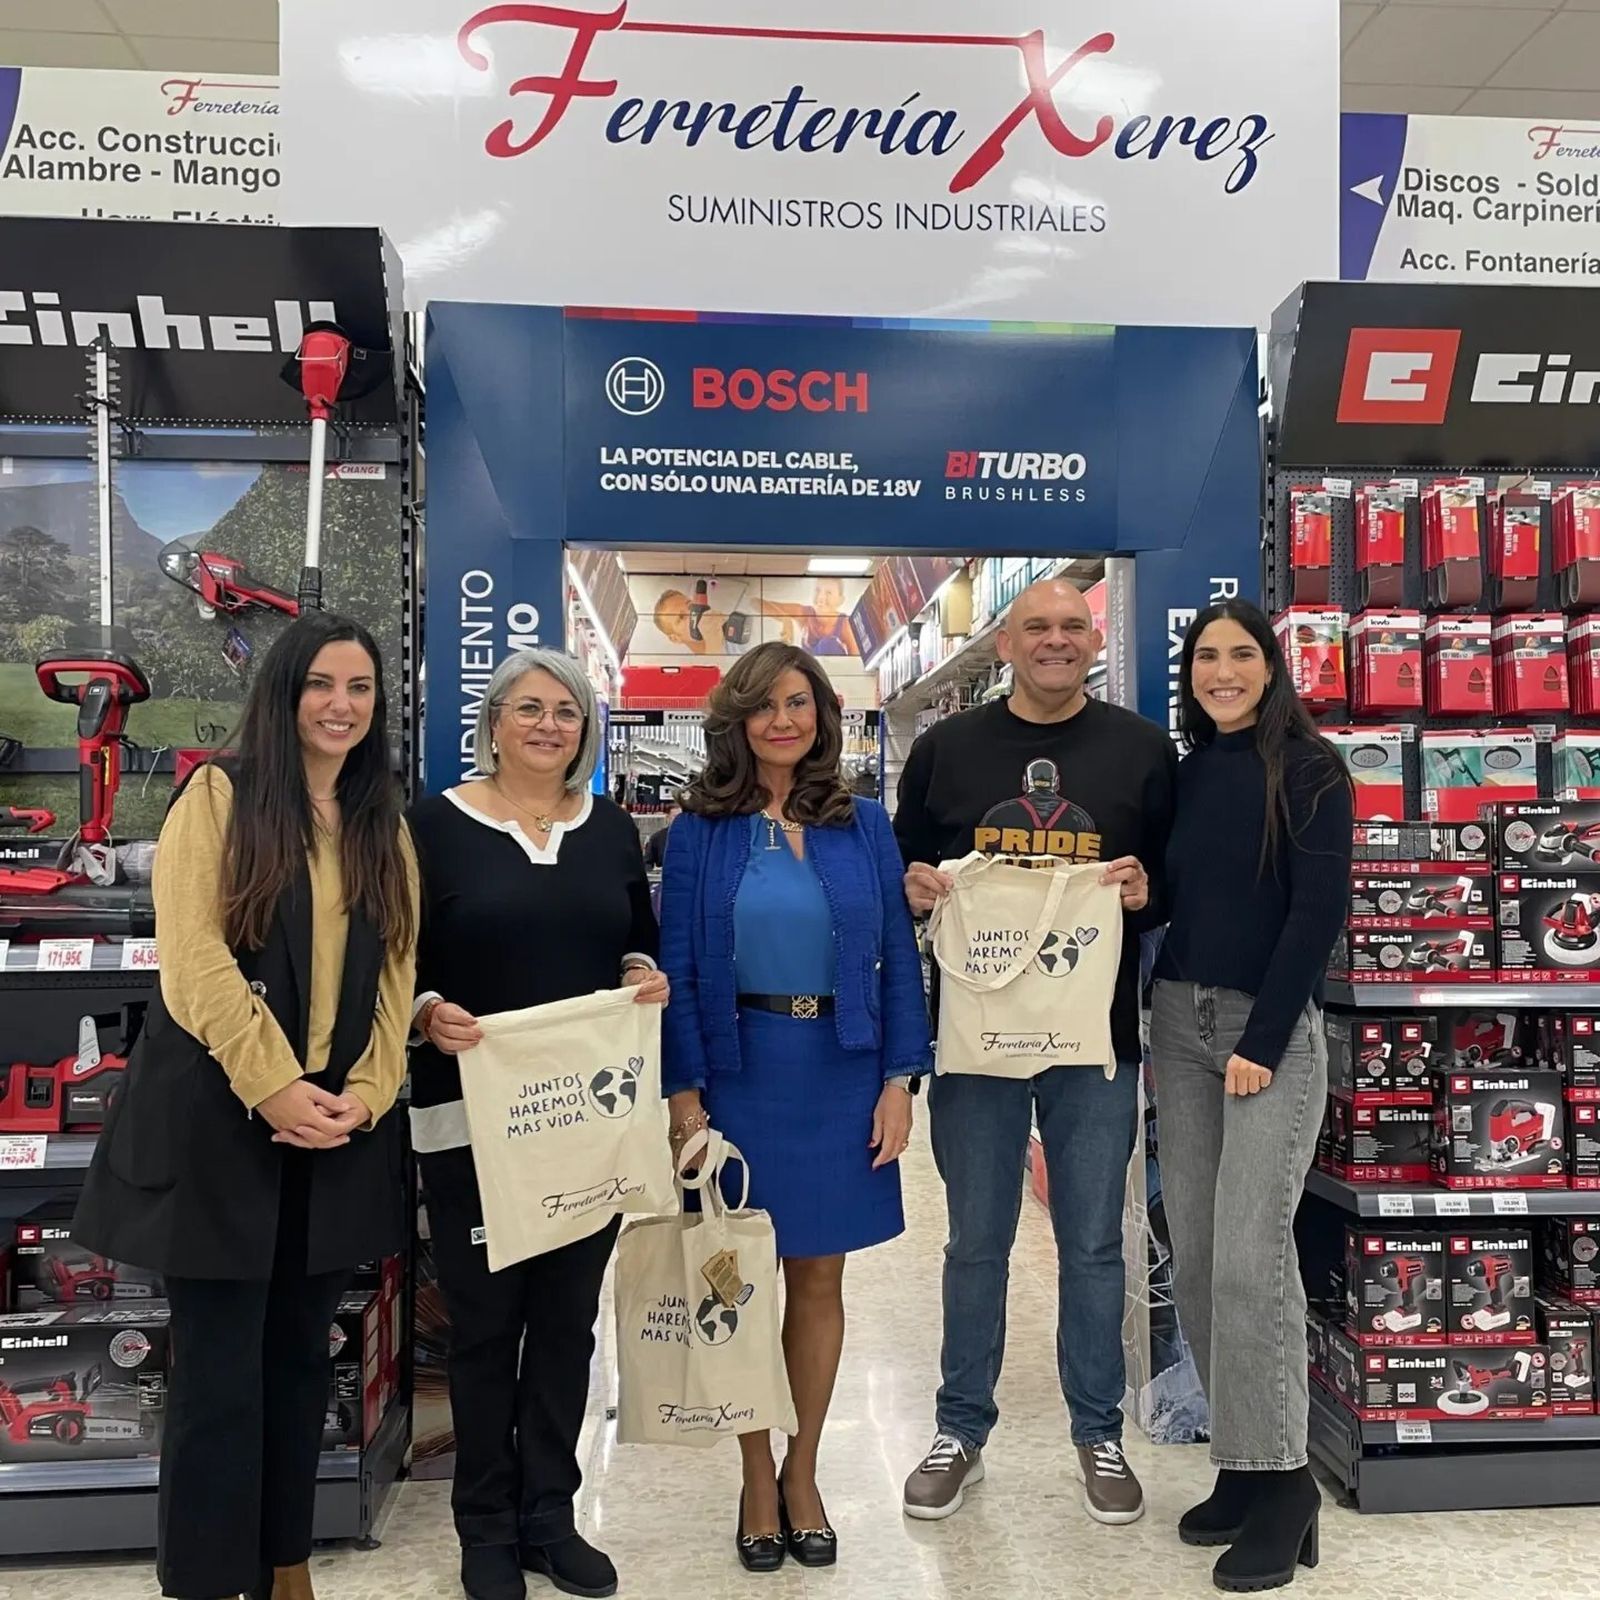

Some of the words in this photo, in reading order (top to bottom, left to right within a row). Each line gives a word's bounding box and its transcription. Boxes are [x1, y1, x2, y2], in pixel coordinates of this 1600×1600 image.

[160, 78, 280, 116] Ferretería
[457, 2, 964, 158] Ferretería
[949, 30, 1275, 194] Xerez
[14, 124, 85, 150] Acc.
[98, 127, 280, 157] Construcci
[3, 154, 141, 183] Alambre
[173, 159, 280, 193] Mango
[1404, 168, 1500, 194] Discos
[1536, 172, 1600, 197] Sold
[668, 194, 882, 230] SUMINISTROS
[896, 201, 1106, 234] INDUSTRIALES
[1397, 194, 1462, 224] Maq.
[1400, 249, 1456, 271] Acc.
[1466, 250, 1600, 274] Fontanería
[693, 367, 869, 413] BOSCH
[600, 447, 628, 466] LA
[632, 447, 739, 468] POTENCIA
[743, 451, 783, 469] DEL
[786, 451, 858, 473] CABLE,
[945, 450, 1086, 481] BITURBO
[600, 473, 646, 491] CON
[650, 470, 707, 493] SÓLO
[711, 475, 757, 494] UNA
[760, 473, 848, 496] BATERÍA
[852, 479, 880, 496] DE
[884, 479, 921, 497] 18V
[945, 486, 1086, 502] BRUSHLESS
[1380, 734, 1400, 742] kwb
[1512, 735, 1533, 744] kwb
[1518, 806, 1560, 814] Einhell
[974, 827, 1101, 858] PRIDE
[1368, 880, 1411, 889] Einhell
[1521, 878, 1577, 888] Einhell
[1369, 934, 1413, 943] Einhell
[47, 950, 82, 967] 171,95€
[518, 1073, 583, 1098] JUNTOS
[1472, 1079, 1529, 1090] Einhell
[510, 1090, 586, 1119] HAREMOS
[507, 1118, 541, 1139] MÁS
[1385, 1242, 1442, 1252] Einhell
[1471, 1240, 1528, 1250] Einhell
[1, 1335, 69, 1349] Einhell
[641, 1326, 671, 1342] MÁS
[1387, 1357, 1446, 1368] Einhell
